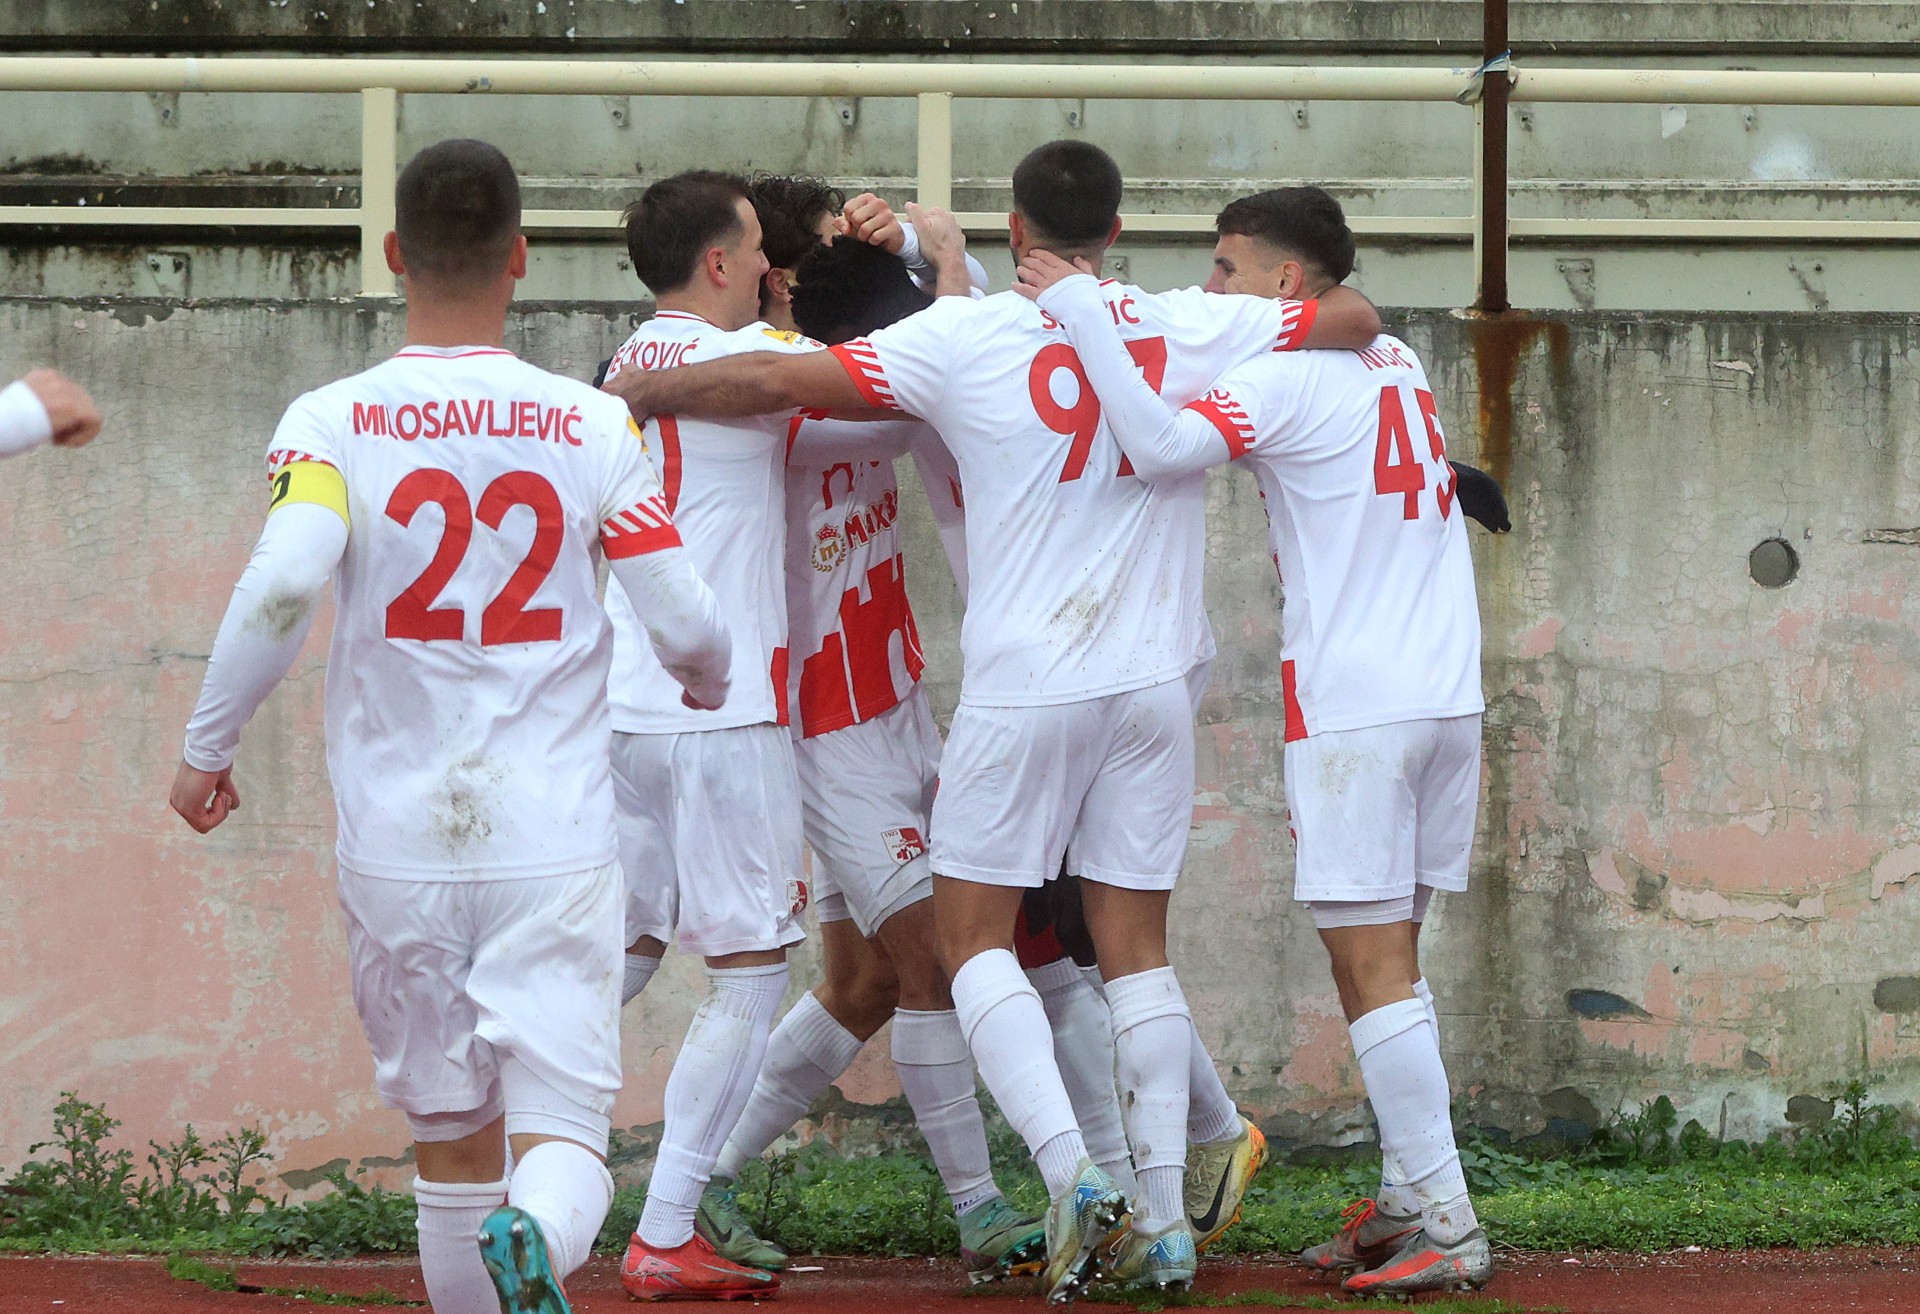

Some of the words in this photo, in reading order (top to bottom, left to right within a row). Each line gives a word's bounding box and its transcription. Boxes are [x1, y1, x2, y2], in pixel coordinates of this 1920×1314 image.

[353, 400, 584, 447] MILOSAVLJEVIĆ
[1374, 385, 1458, 522] 45
[385, 468, 564, 647] 22
